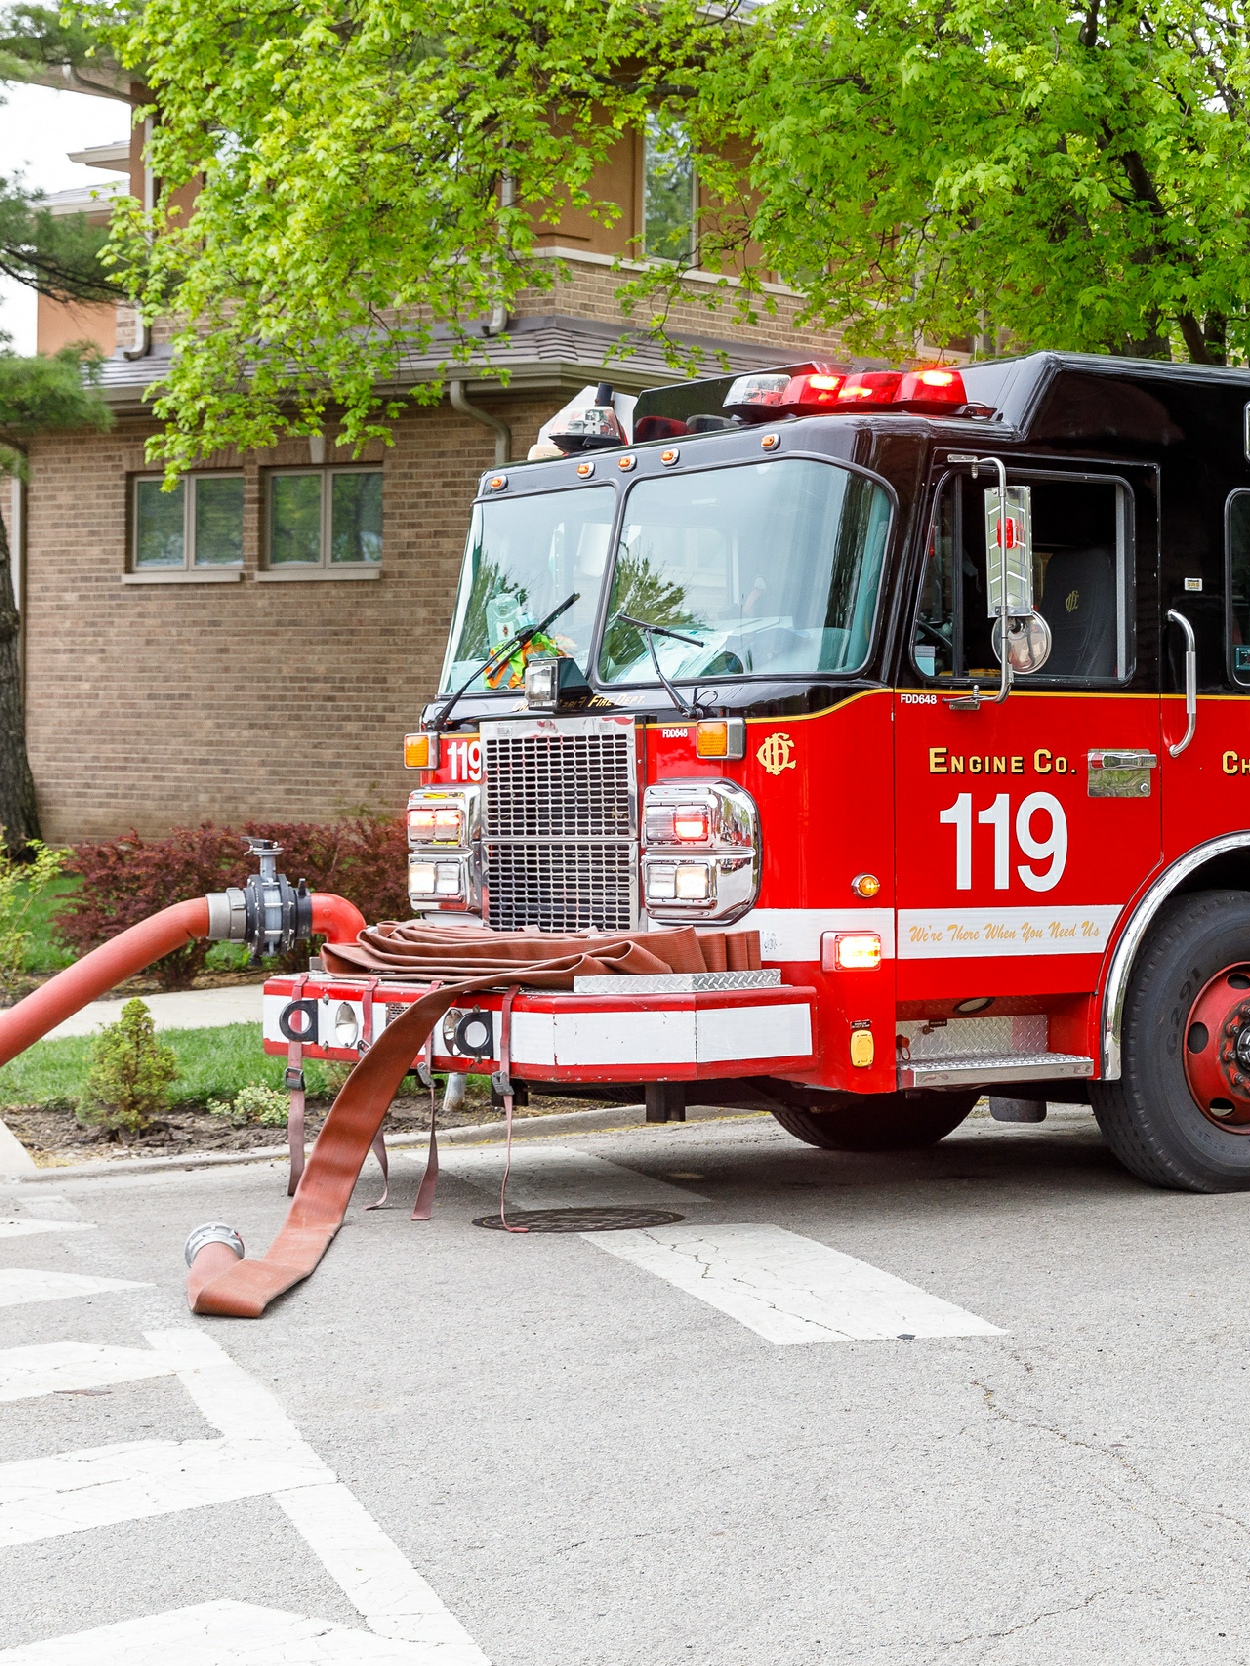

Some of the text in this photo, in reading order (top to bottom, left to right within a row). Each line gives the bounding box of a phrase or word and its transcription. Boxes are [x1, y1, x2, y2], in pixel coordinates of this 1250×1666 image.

[900, 694, 937, 705] FDD648
[447, 741, 481, 781] 119
[929, 747, 1025, 774] ENGINE
[940, 791, 1067, 892] 119
[909, 920, 1101, 943] We're There When You Need Us
